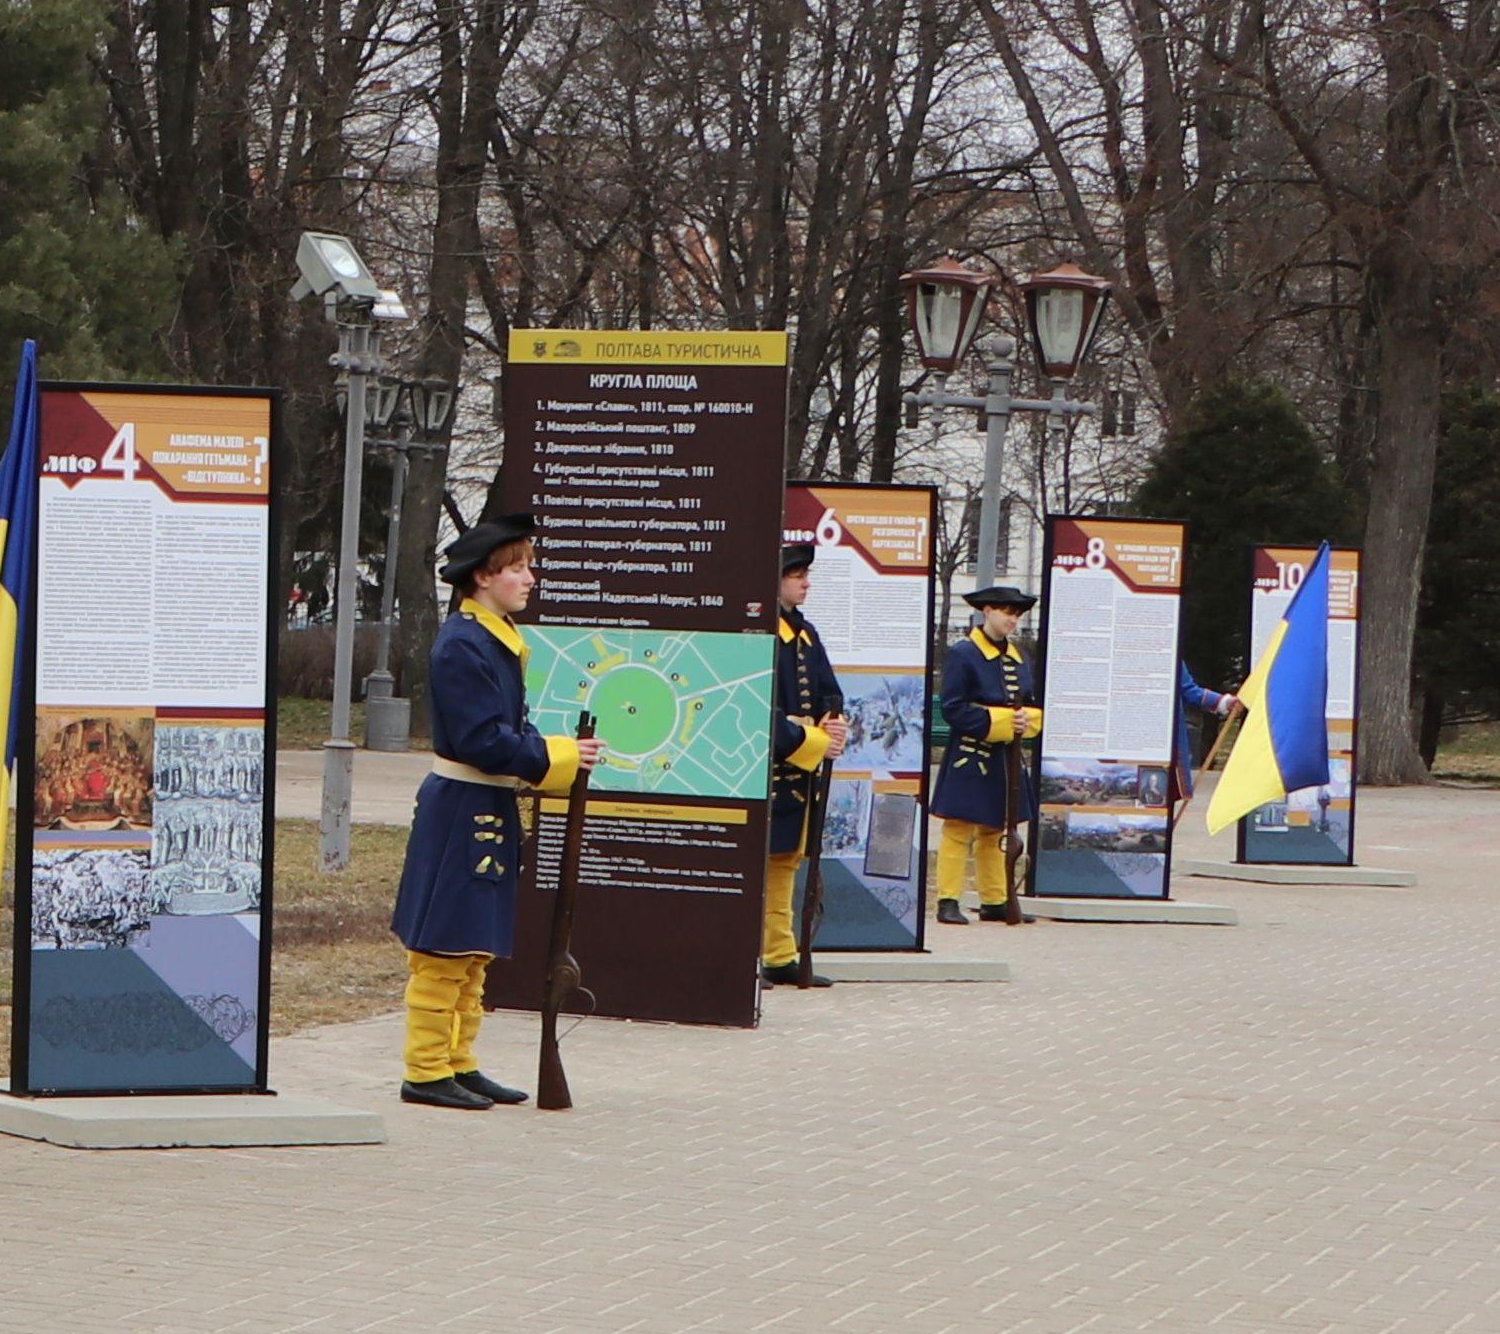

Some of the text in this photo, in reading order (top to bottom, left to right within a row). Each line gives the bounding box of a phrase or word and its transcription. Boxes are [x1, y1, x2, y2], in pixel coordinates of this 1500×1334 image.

[595, 342, 762, 359] ПОЛТАВА ТУРИСТИЧНА
[589, 373, 698, 391] КРУГЛА ПЛОЩА
[547, 400, 593, 413] Монумент
[640, 401, 666, 413] 1811,
[666, 404, 692, 414] охор.
[546, 421, 624, 434] Малоросійський
[625, 424, 670, 434] поштамт,
[672, 423, 696, 433] 1809
[101, 422, 140, 481] 4
[544, 441, 602, 455] Дворянське
[603, 442, 648, 456] зібрання,
[544, 462, 595, 478] Губернські
[595, 464, 657, 477] присутствені
[658, 465, 689, 477] місця,
[691, 466, 714, 476] 1811
[543, 494, 582, 505] Повітові
[583, 496, 644, 509] присутствені
[645, 497, 676, 509] місця,
[678, 497, 701, 508] 1811
[542, 515, 583, 528] Будинок
[584, 517, 637, 528] цивільного
[638, 518, 700, 531] губернатора,
[702, 520, 725, 530] 1811
[816, 508, 842, 547] 6
[541, 536, 582, 549] Будинок
[583, 537, 687, 553] генерал-губернатора,
[688, 540, 711, 551] 1811
[1086, 537, 1106, 569] 8
[541, 557, 582, 571] Будинок
[582, 559, 668, 574] віце-губернатора,
[671, 561, 693, 572] 1811
[540, 578, 601, 591] Полтавський
[1276, 562, 1304, 590] 10
[539, 590, 600, 603] Петровський
[601, 592, 658, 604] Кадетський
[659, 594, 698, 607] Корпус,
